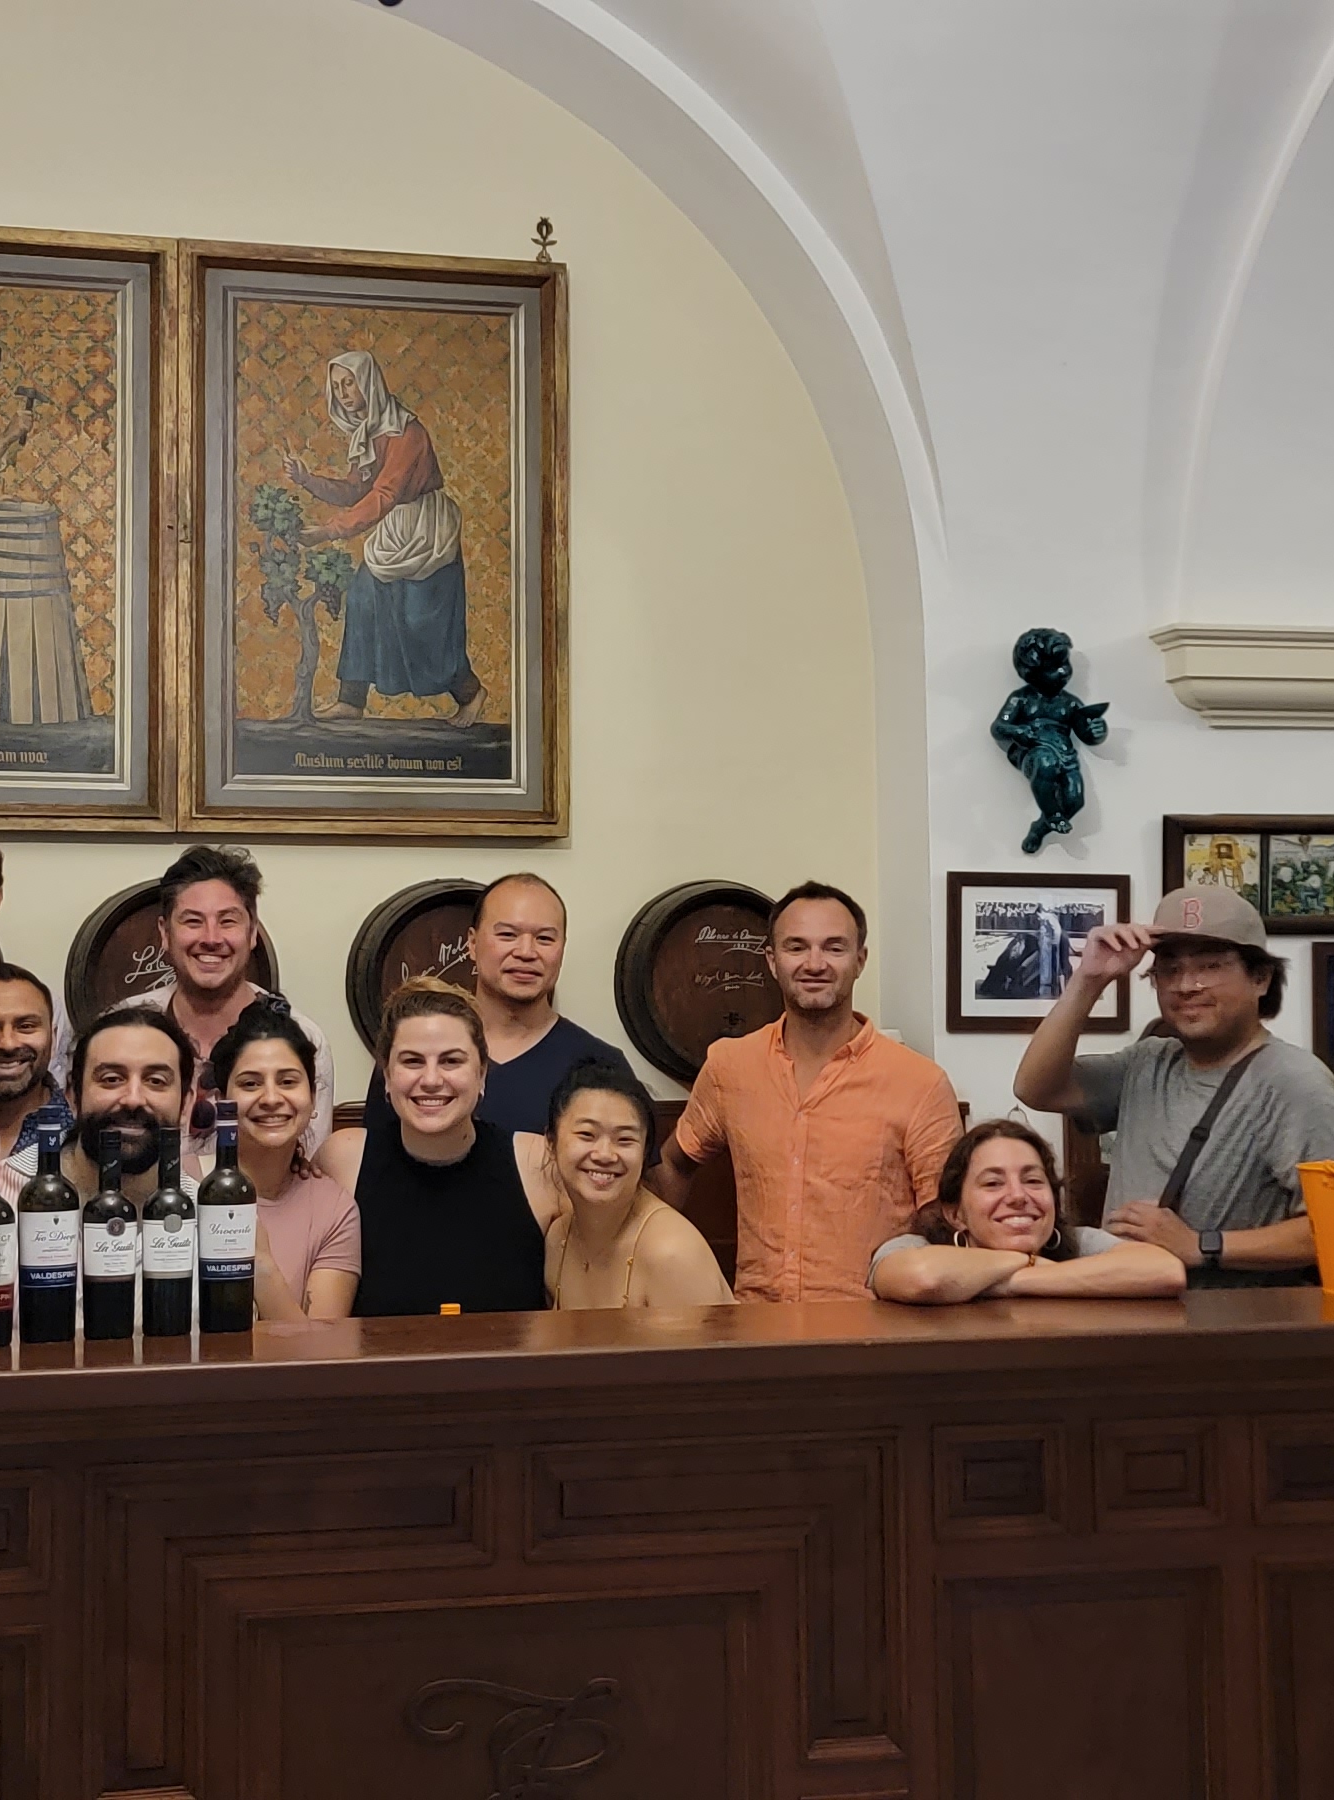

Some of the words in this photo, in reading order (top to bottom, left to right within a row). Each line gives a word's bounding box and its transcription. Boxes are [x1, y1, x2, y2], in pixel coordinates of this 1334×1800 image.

[387, 754, 423, 770] bonum
[1183, 897, 1203, 929] B
[206, 1263, 252, 1272] VALDESPINO
